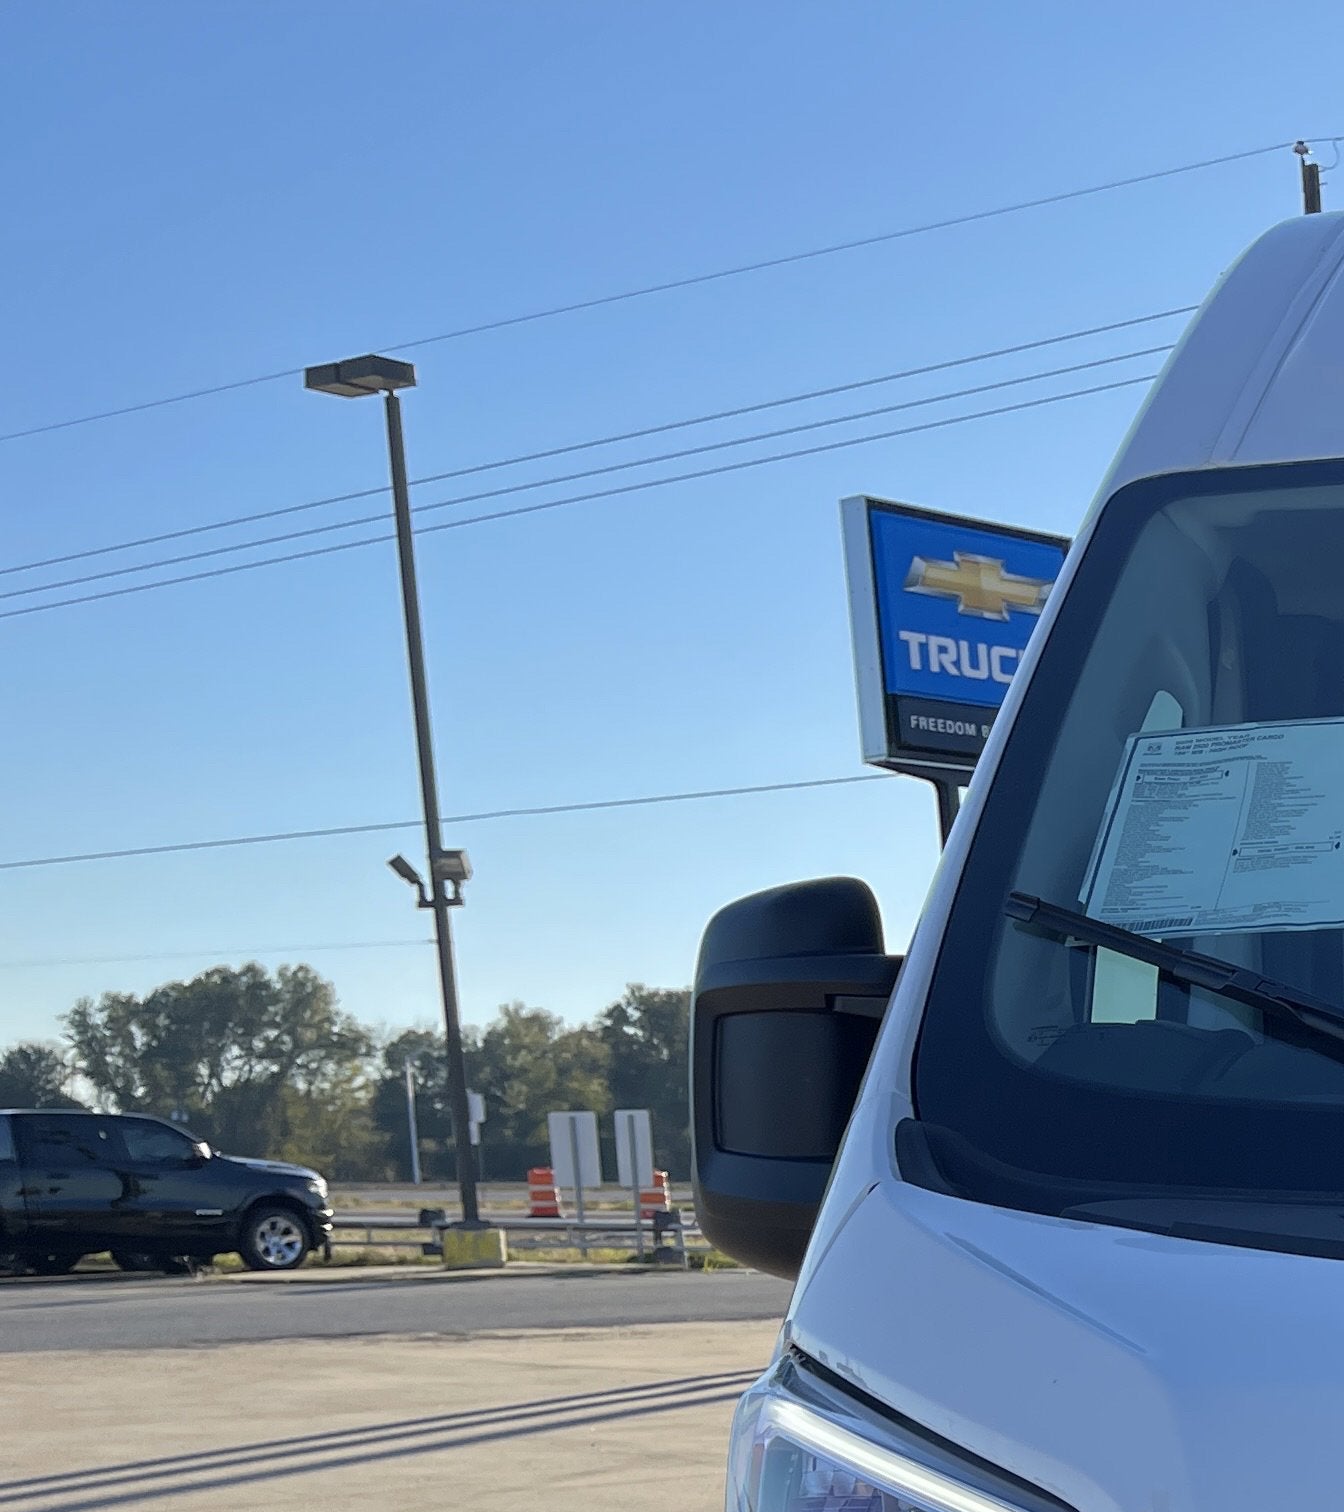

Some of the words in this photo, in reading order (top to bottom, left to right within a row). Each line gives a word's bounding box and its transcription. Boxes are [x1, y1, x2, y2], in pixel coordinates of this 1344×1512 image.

[899, 630, 1025, 684] TRUC
[910, 715, 977, 737] FREEDOM
[981, 725, 992, 738] B
